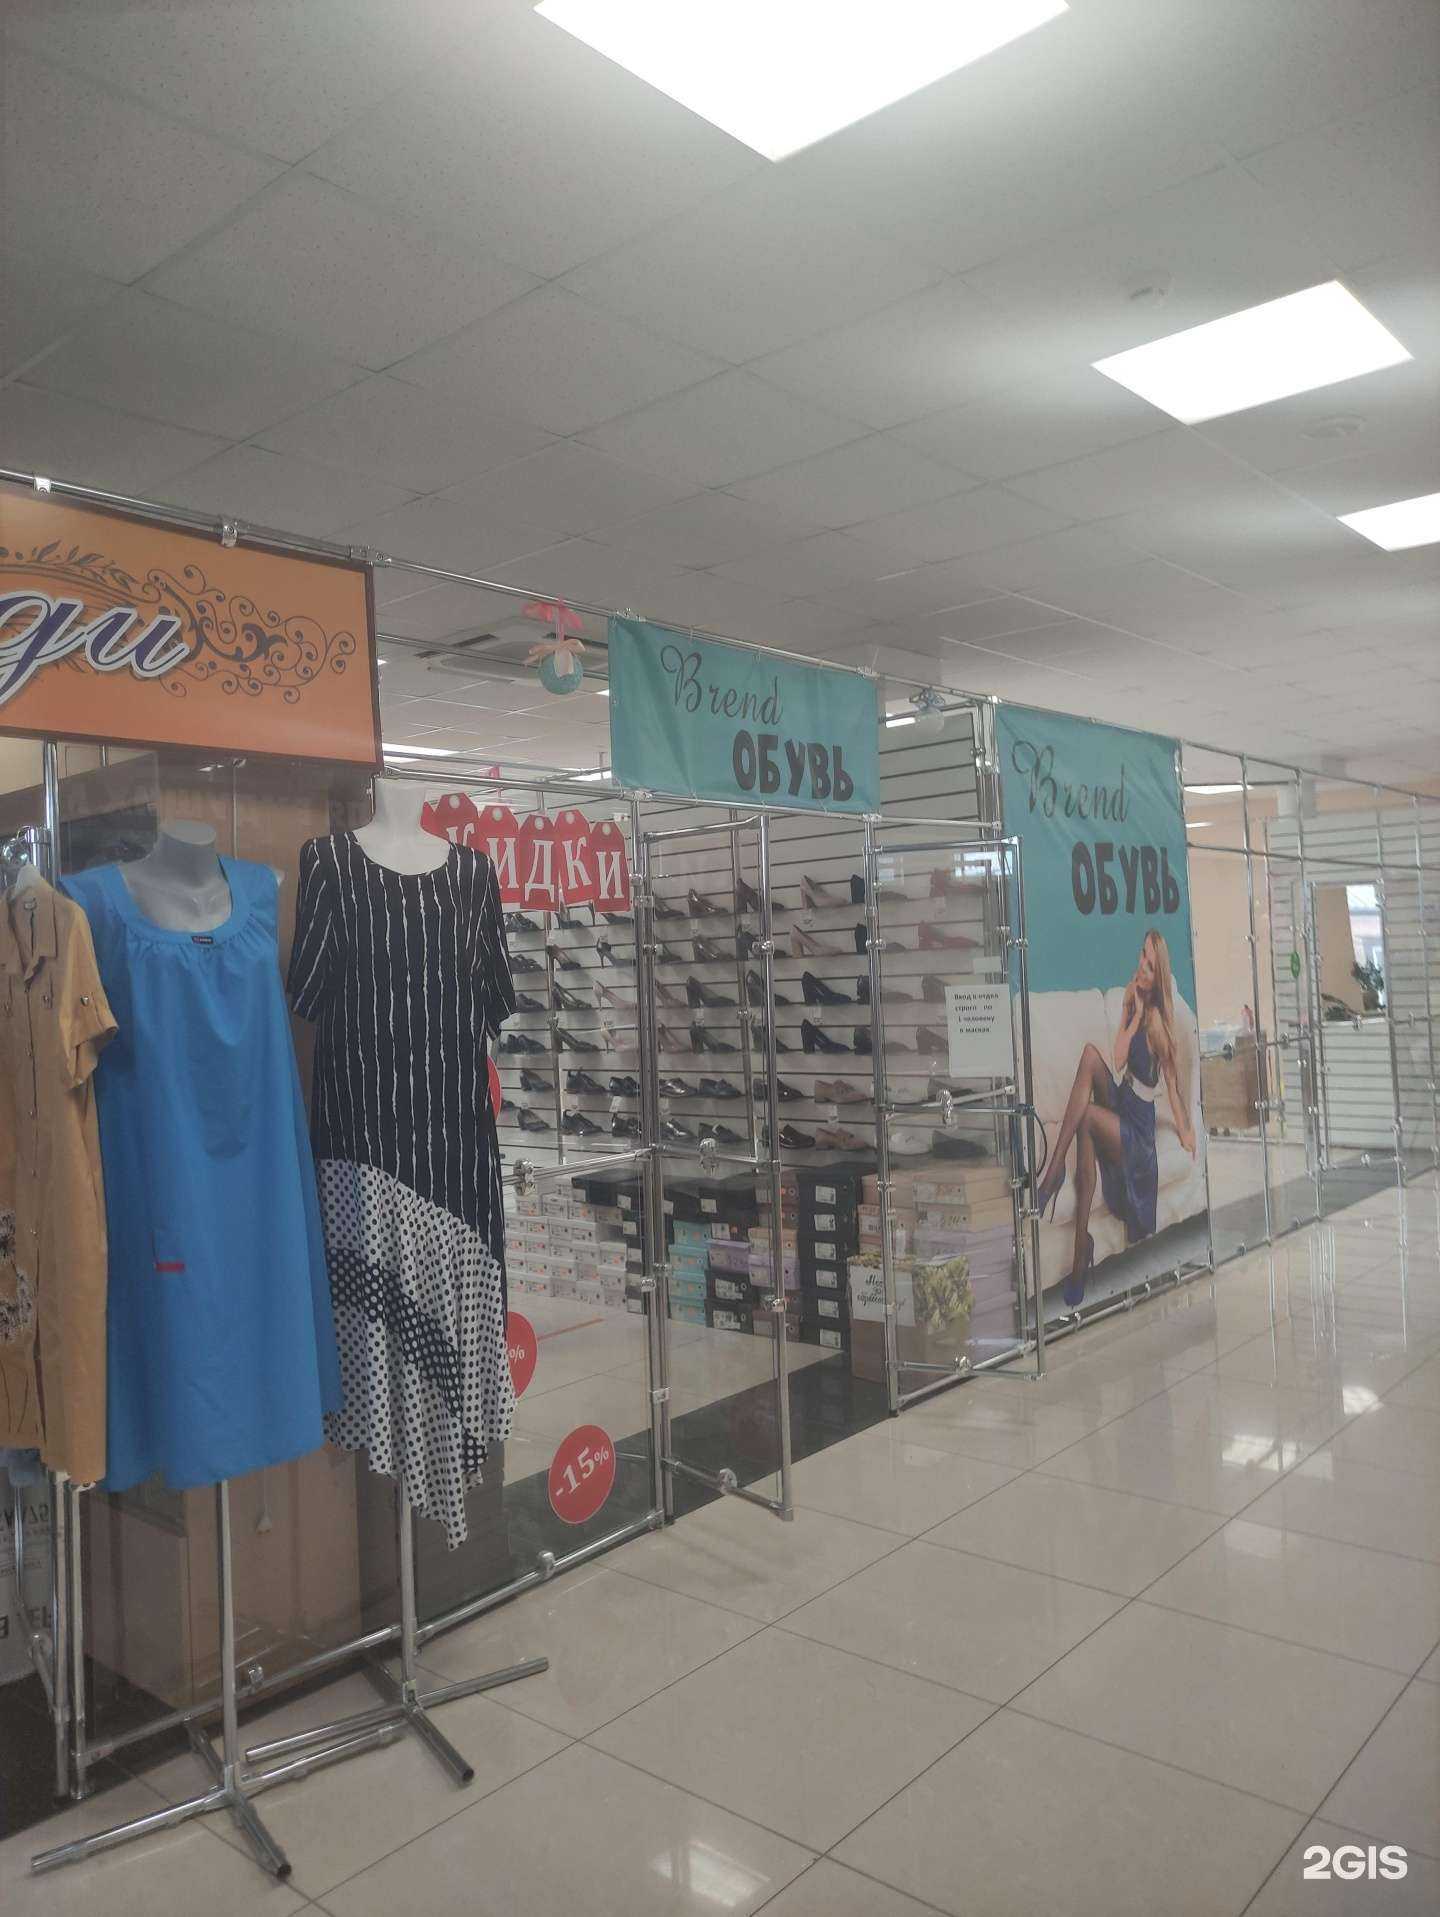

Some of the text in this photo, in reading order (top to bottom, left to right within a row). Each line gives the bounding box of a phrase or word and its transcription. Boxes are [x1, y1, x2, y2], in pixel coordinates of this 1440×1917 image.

[661, 644, 783, 726] Brend
[733, 729, 854, 801] ОБУВЬ
[1012, 740, 1130, 823] Brend
[1071, 840, 1180, 916] ОБУВЬ
[556, 1447, 609, 1497] -15%
